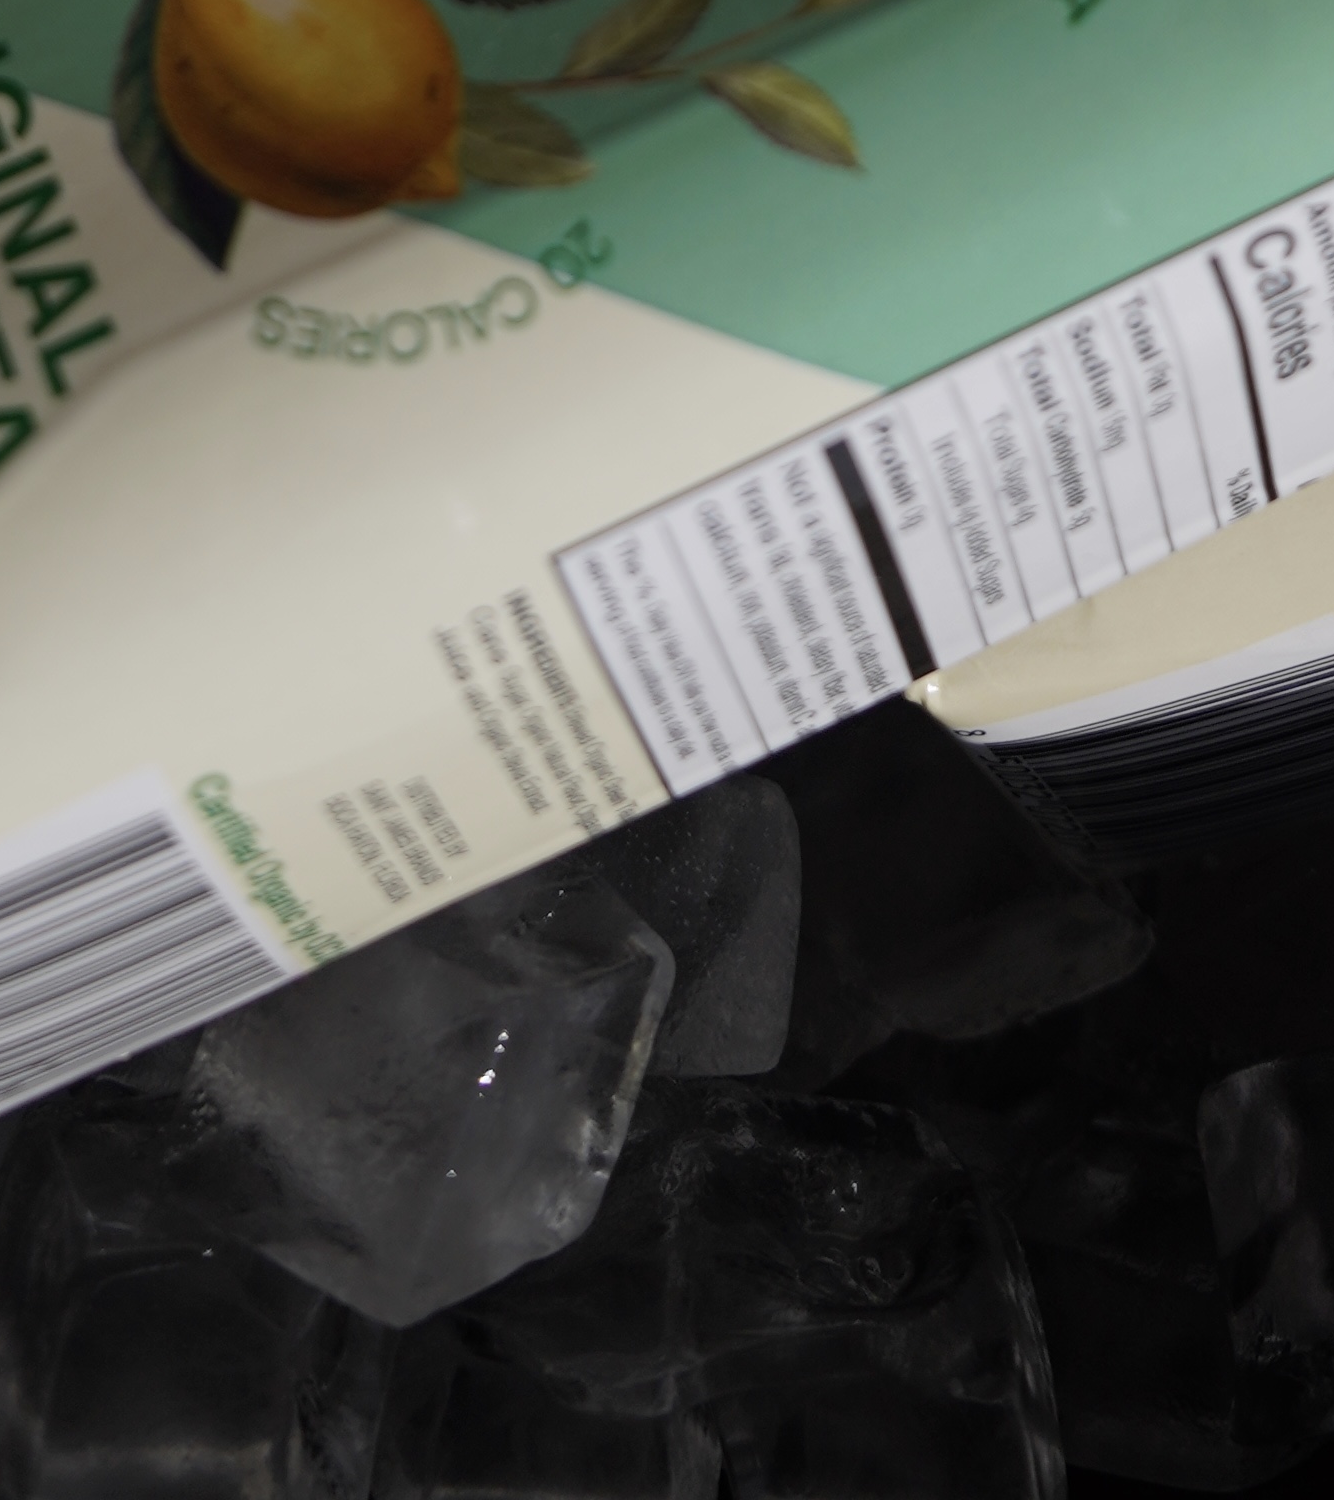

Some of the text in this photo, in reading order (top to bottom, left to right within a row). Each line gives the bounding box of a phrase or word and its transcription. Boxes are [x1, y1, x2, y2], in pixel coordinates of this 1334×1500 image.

[253, 275, 540, 365] CALORIES
[1243, 225, 1321, 383] Calories
[1043, 412, 1087, 509] Carbohydrate
